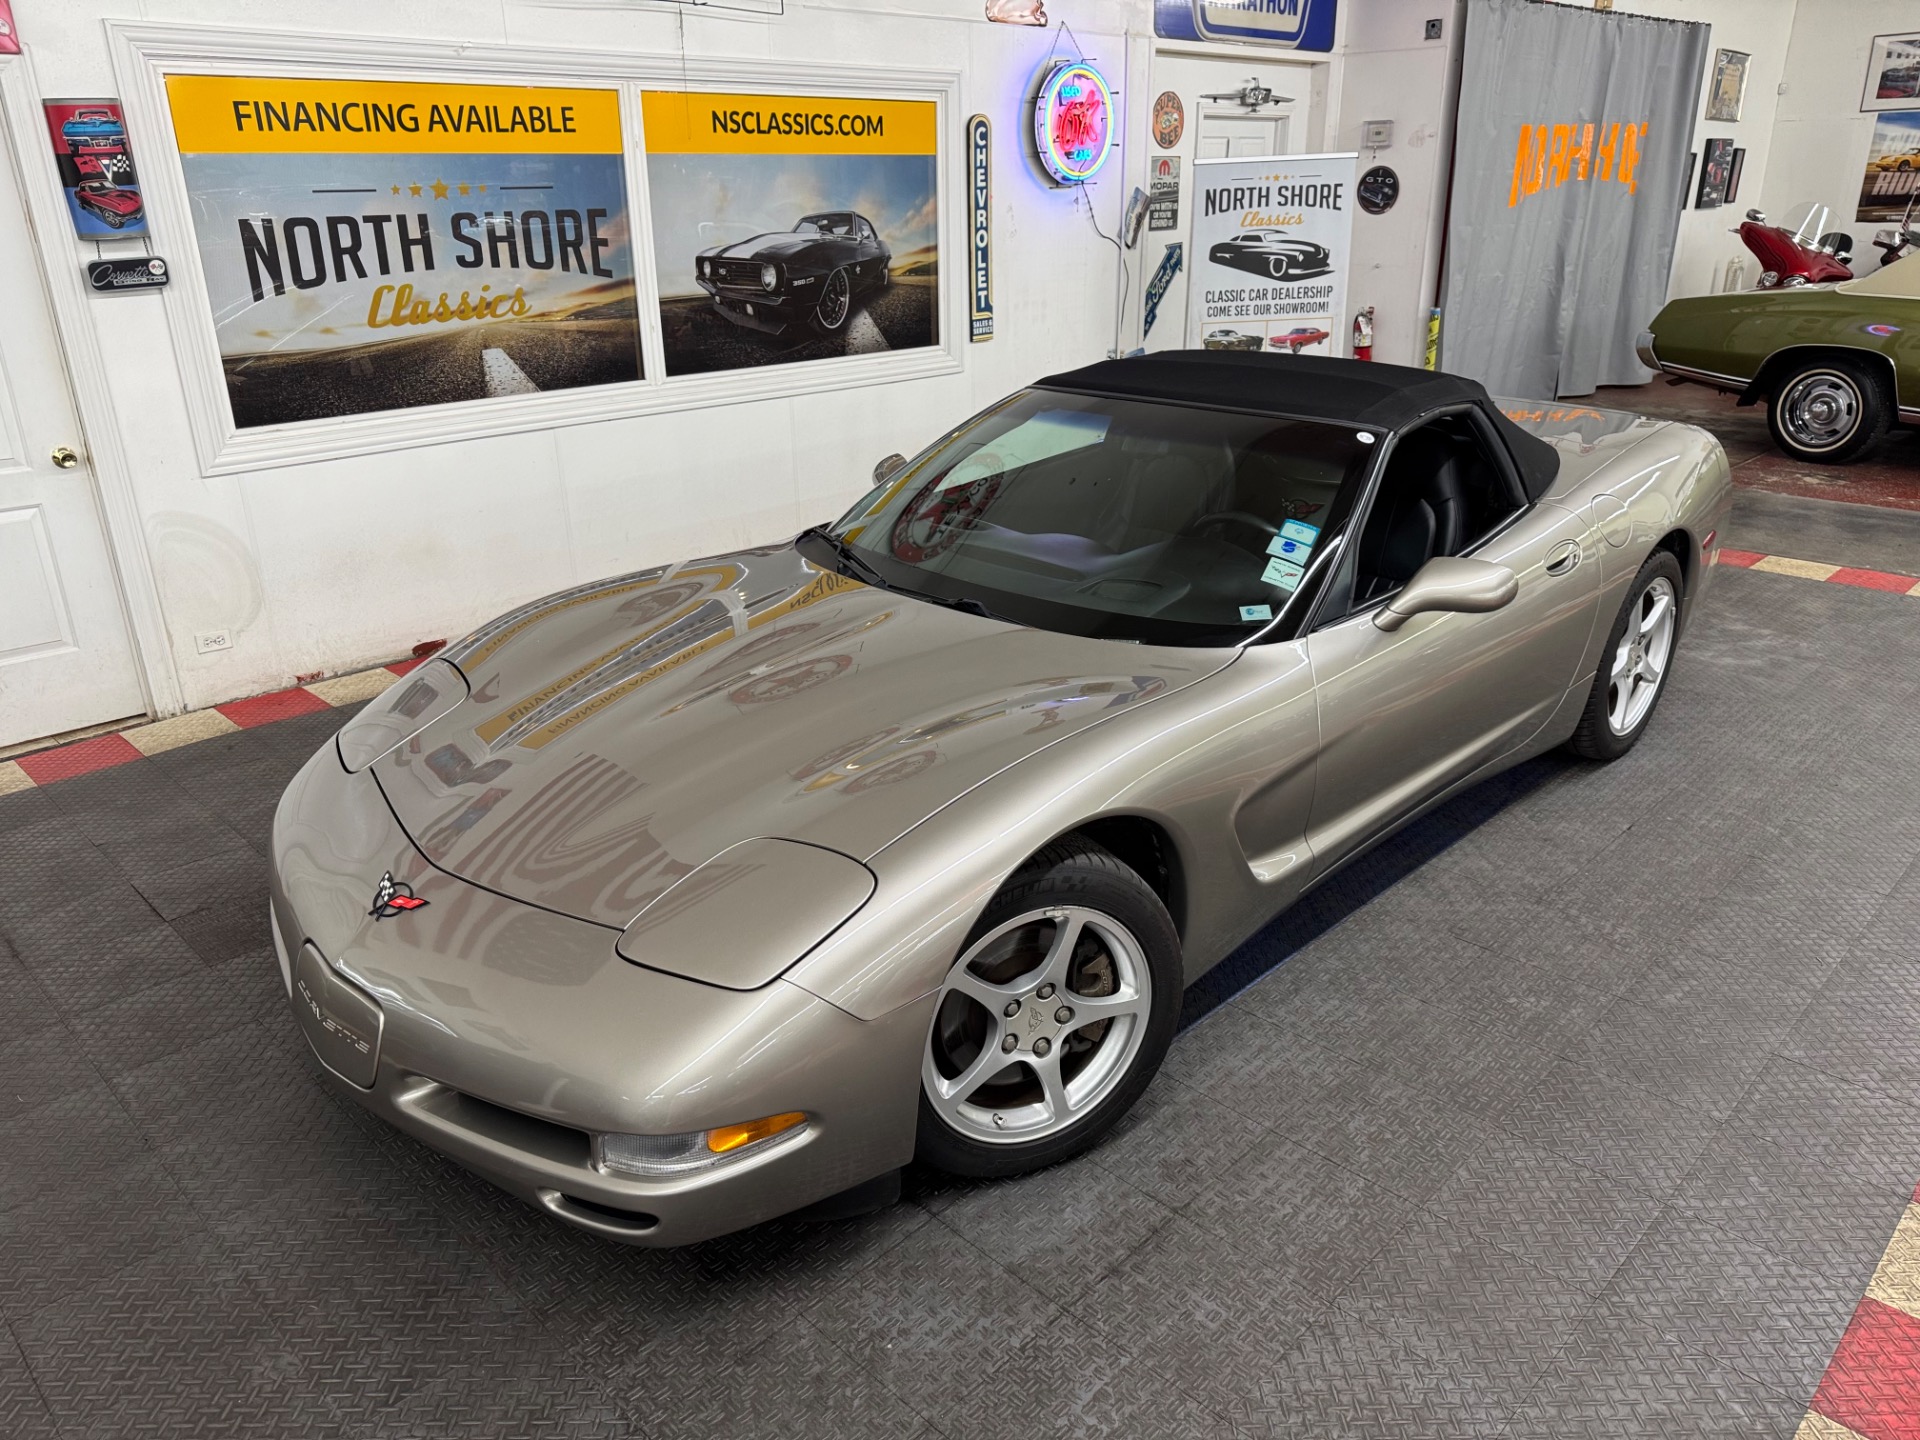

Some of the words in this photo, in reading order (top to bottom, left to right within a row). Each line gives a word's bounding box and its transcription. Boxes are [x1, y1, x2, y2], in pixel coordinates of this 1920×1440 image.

[232, 100, 420, 132] FINANCING
[428, 104, 577, 134] AVAILABLE
[712, 110, 884, 136] NSCLASSICS.COM
[1160, 125, 1179, 145] BEE
[1150, 182, 1179, 191] MOPAR
[1366, 176, 1394, 184] GTO
[1204, 186, 1270, 217] NORTH
[1277, 183, 1344, 211] SHORE
[975, 126, 988, 308] CHEVROLET
[1240, 211, 1305, 228] Classics
[238, 213, 435, 302] NORTH
[451, 208, 614, 279] SHORE
[91, 264, 152, 286] Corvette
[1151, 263, 1173, 303] Ford
[1205, 289, 1246, 304] CLASSIC
[1250, 288, 1269, 301] CAR
[1271, 285, 1333, 300] DEALERSHIP
[367, 283, 533, 329] Classics
[1207, 305, 1232, 318] COME
[1234, 304, 1254, 316] SEE
[1254, 304, 1271, 315] OUR
[1273, 301, 1329, 315] SHOWROOM!
[973, 319, 988, 327] SALES
[973, 326, 992, 335] SERVICE
[298, 980, 370, 1054] CORVETTE
